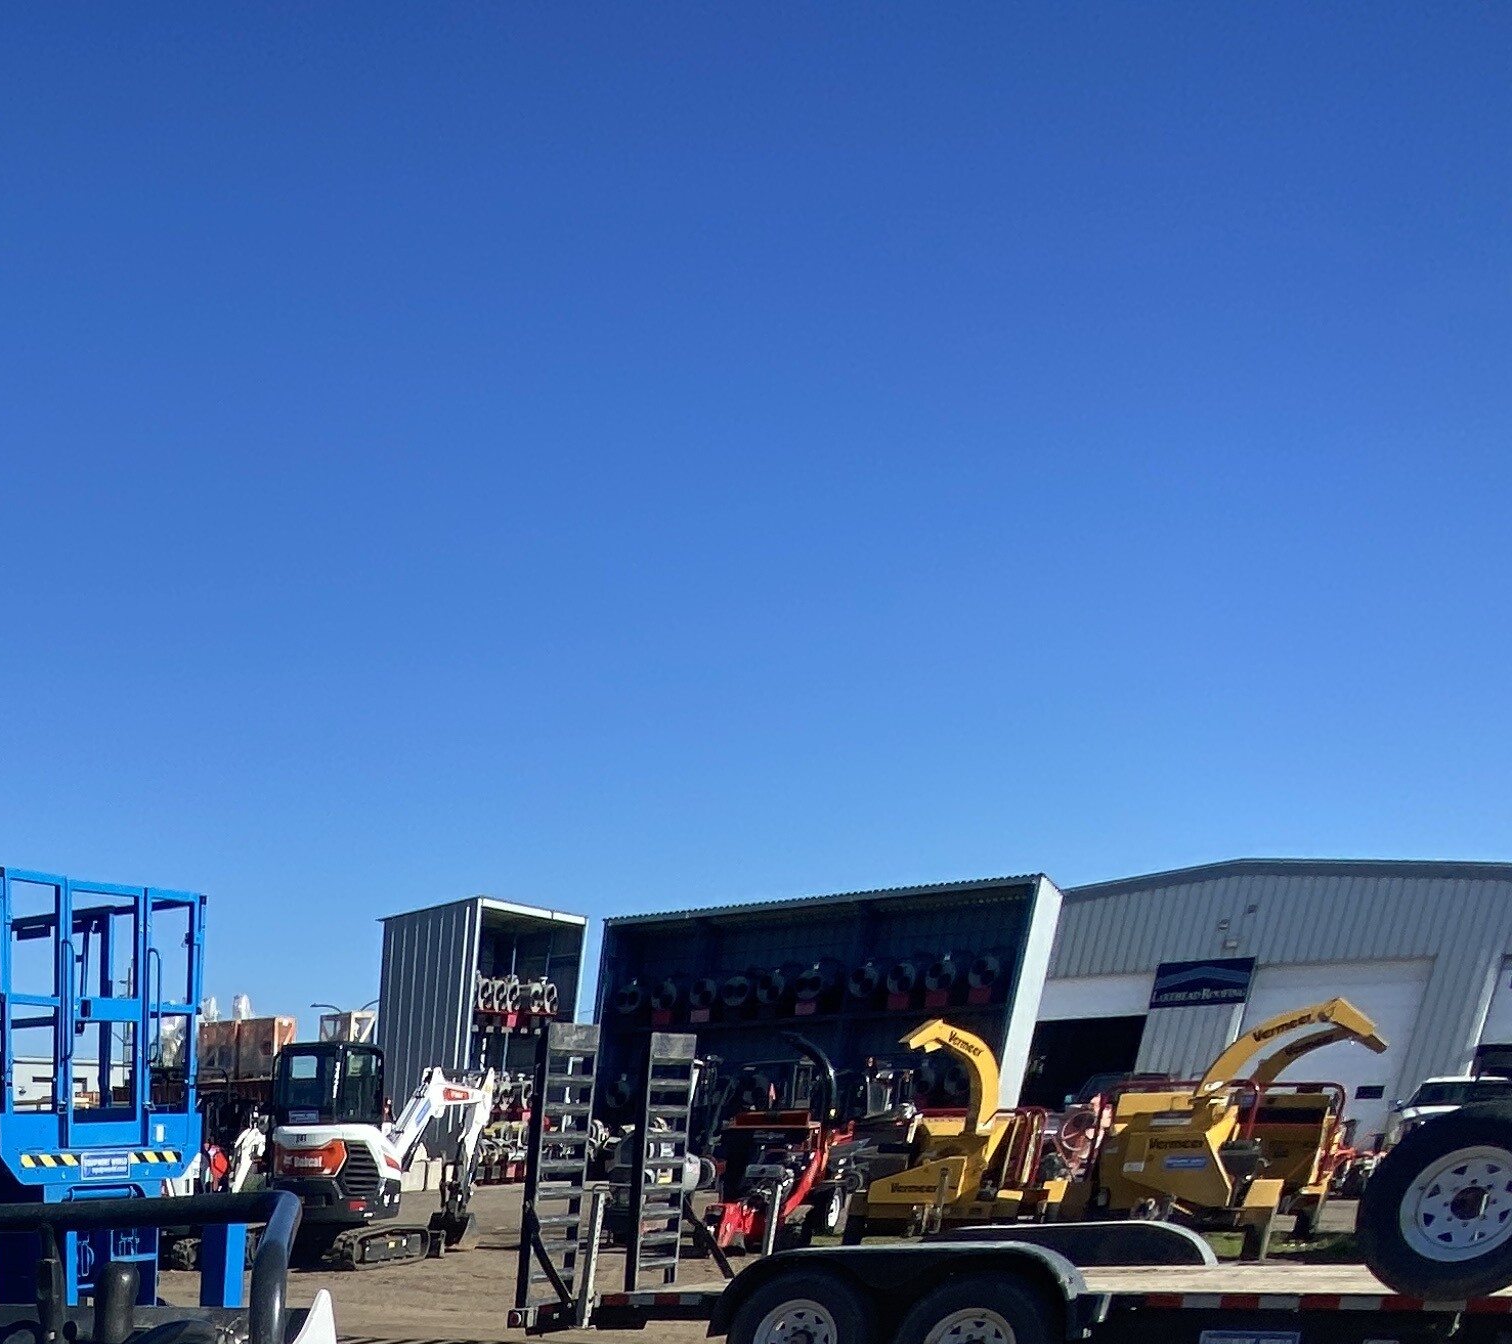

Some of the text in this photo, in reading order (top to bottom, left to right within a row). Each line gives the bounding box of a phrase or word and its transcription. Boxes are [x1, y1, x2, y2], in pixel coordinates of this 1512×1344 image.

[1253, 1013, 1312, 1042] Vermeer
[948, 1030, 985, 1057] Vermeer
[294, 1156, 323, 1167] Bobcat
